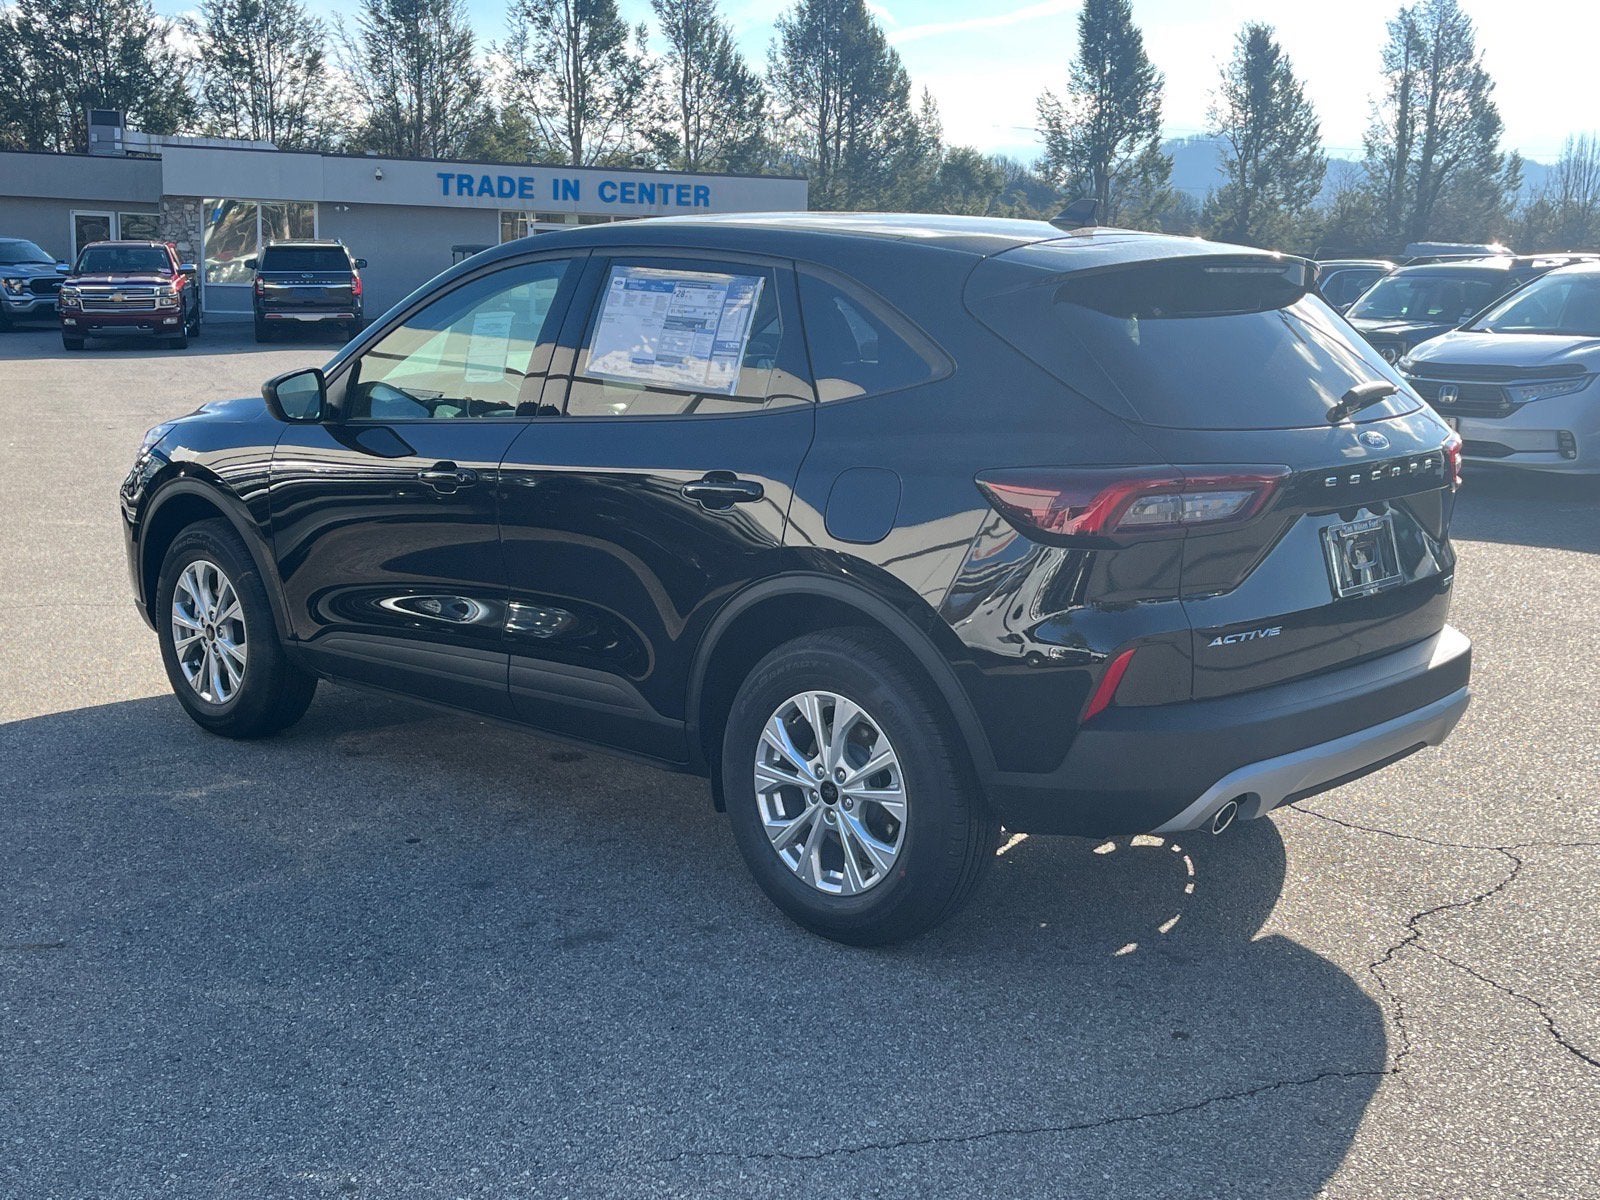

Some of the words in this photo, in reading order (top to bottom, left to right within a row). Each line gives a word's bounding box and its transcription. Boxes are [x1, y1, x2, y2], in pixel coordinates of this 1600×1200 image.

[437, 173, 535, 199] TRADE
[553, 179, 580, 201] IN
[598, 181, 710, 207] CENTER
[1325, 459, 1432, 487] ESCAPE
[1208, 626, 1283, 647] ACTIVE
